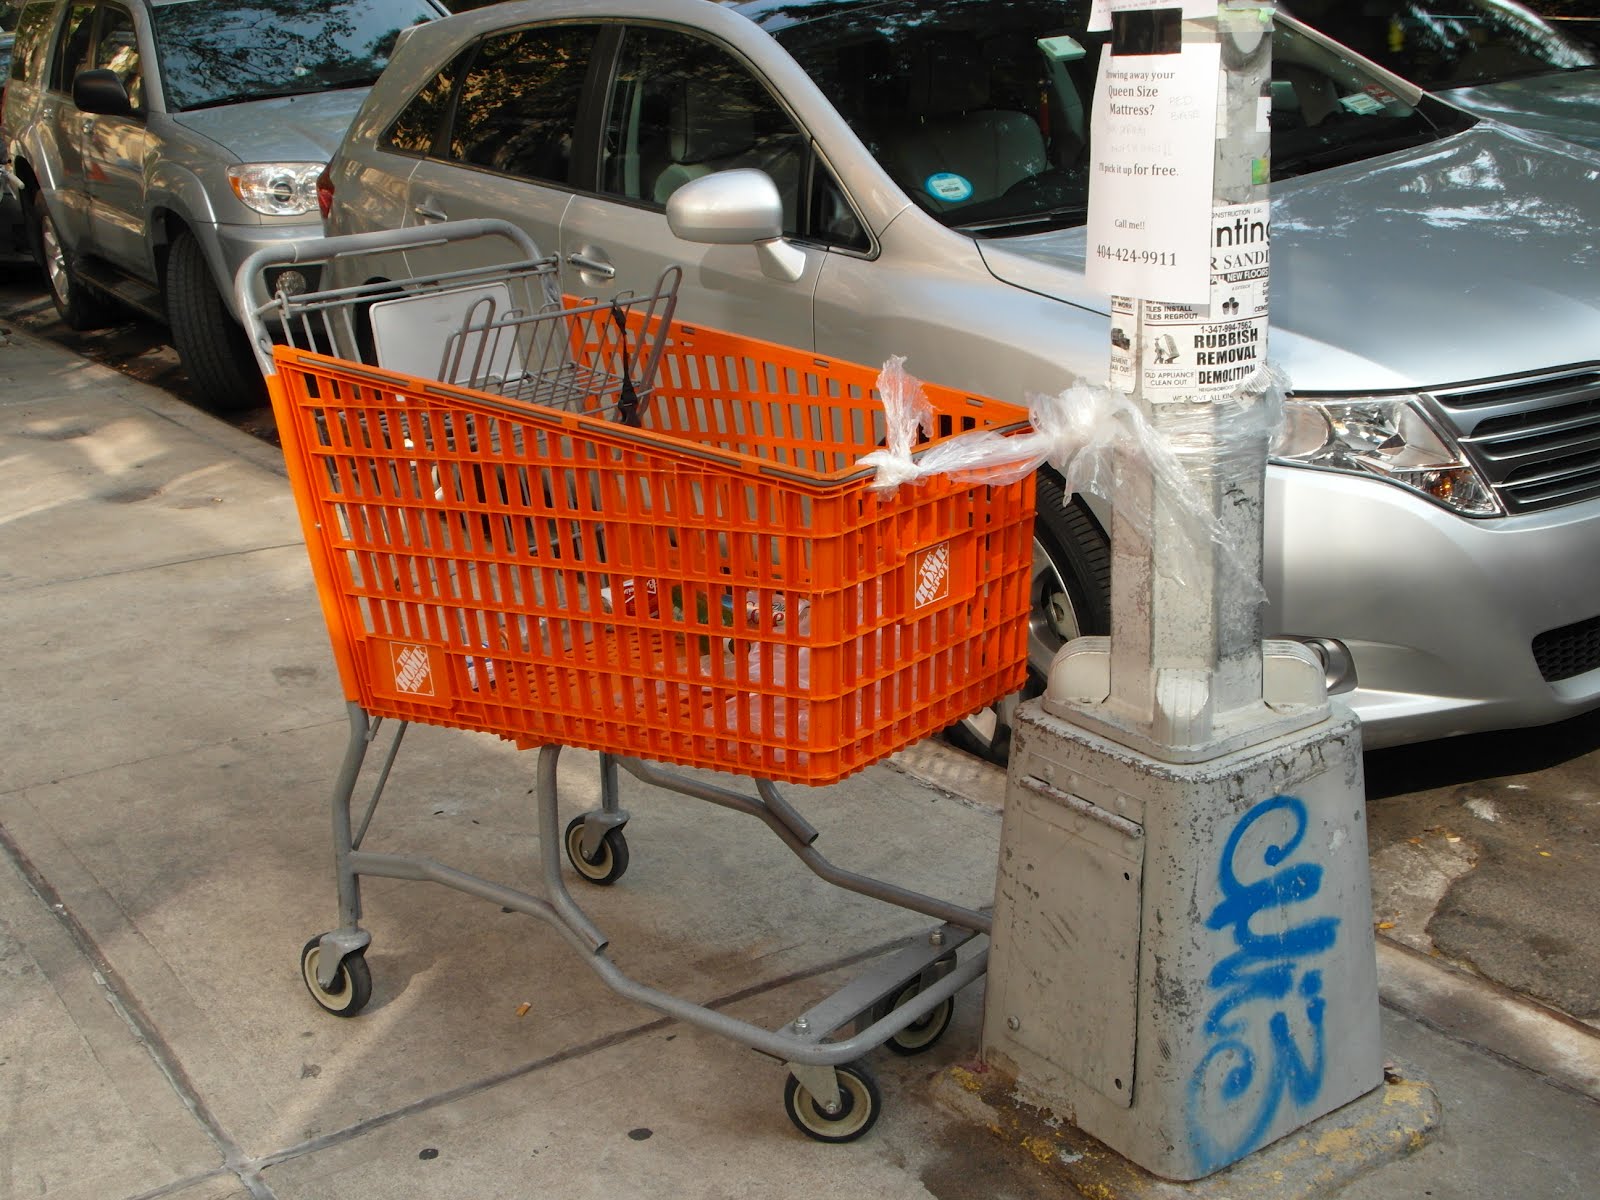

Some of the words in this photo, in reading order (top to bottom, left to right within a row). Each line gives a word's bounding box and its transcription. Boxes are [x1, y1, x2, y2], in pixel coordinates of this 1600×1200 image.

[1129, 71, 1149, 82] away
[1151, 71, 1175, 82] your
[1108, 85, 1134, 99] Queen
[1136, 85, 1158, 97] Size
[1109, 103, 1155, 116] Mattress?
[1116, 164, 1122, 174] it
[1123, 167, 1132, 177] up
[1133, 163, 1149, 175] for
[1151, 164, 1179, 176] free.
[1114, 218, 1127, 229] Call
[1128, 221, 1145, 230] me!!
[1096, 244, 1177, 267] 404-424-9911
[1226, 271, 1244, 282] NEW
[1244, 268, 1269, 279] FLOORS
[1145, 305, 1162, 313] TILES
[1164, 312, 1199, 320] REGROUT
[1193, 328, 1258, 349] RUBBISH
[1196, 345, 1257, 366] REMOVAL
[1144, 371, 1156, 379] OLD
[1157, 371, 1195, 379] APPLIANCE
[919, 551, 934, 577] THE
[916, 545, 948, 605] HOME
[926, 561, 949, 601] DEPOT
[397, 646, 411, 667] THE
[396, 647, 428, 691] HOME
[410, 662, 430, 693] DEPOT
